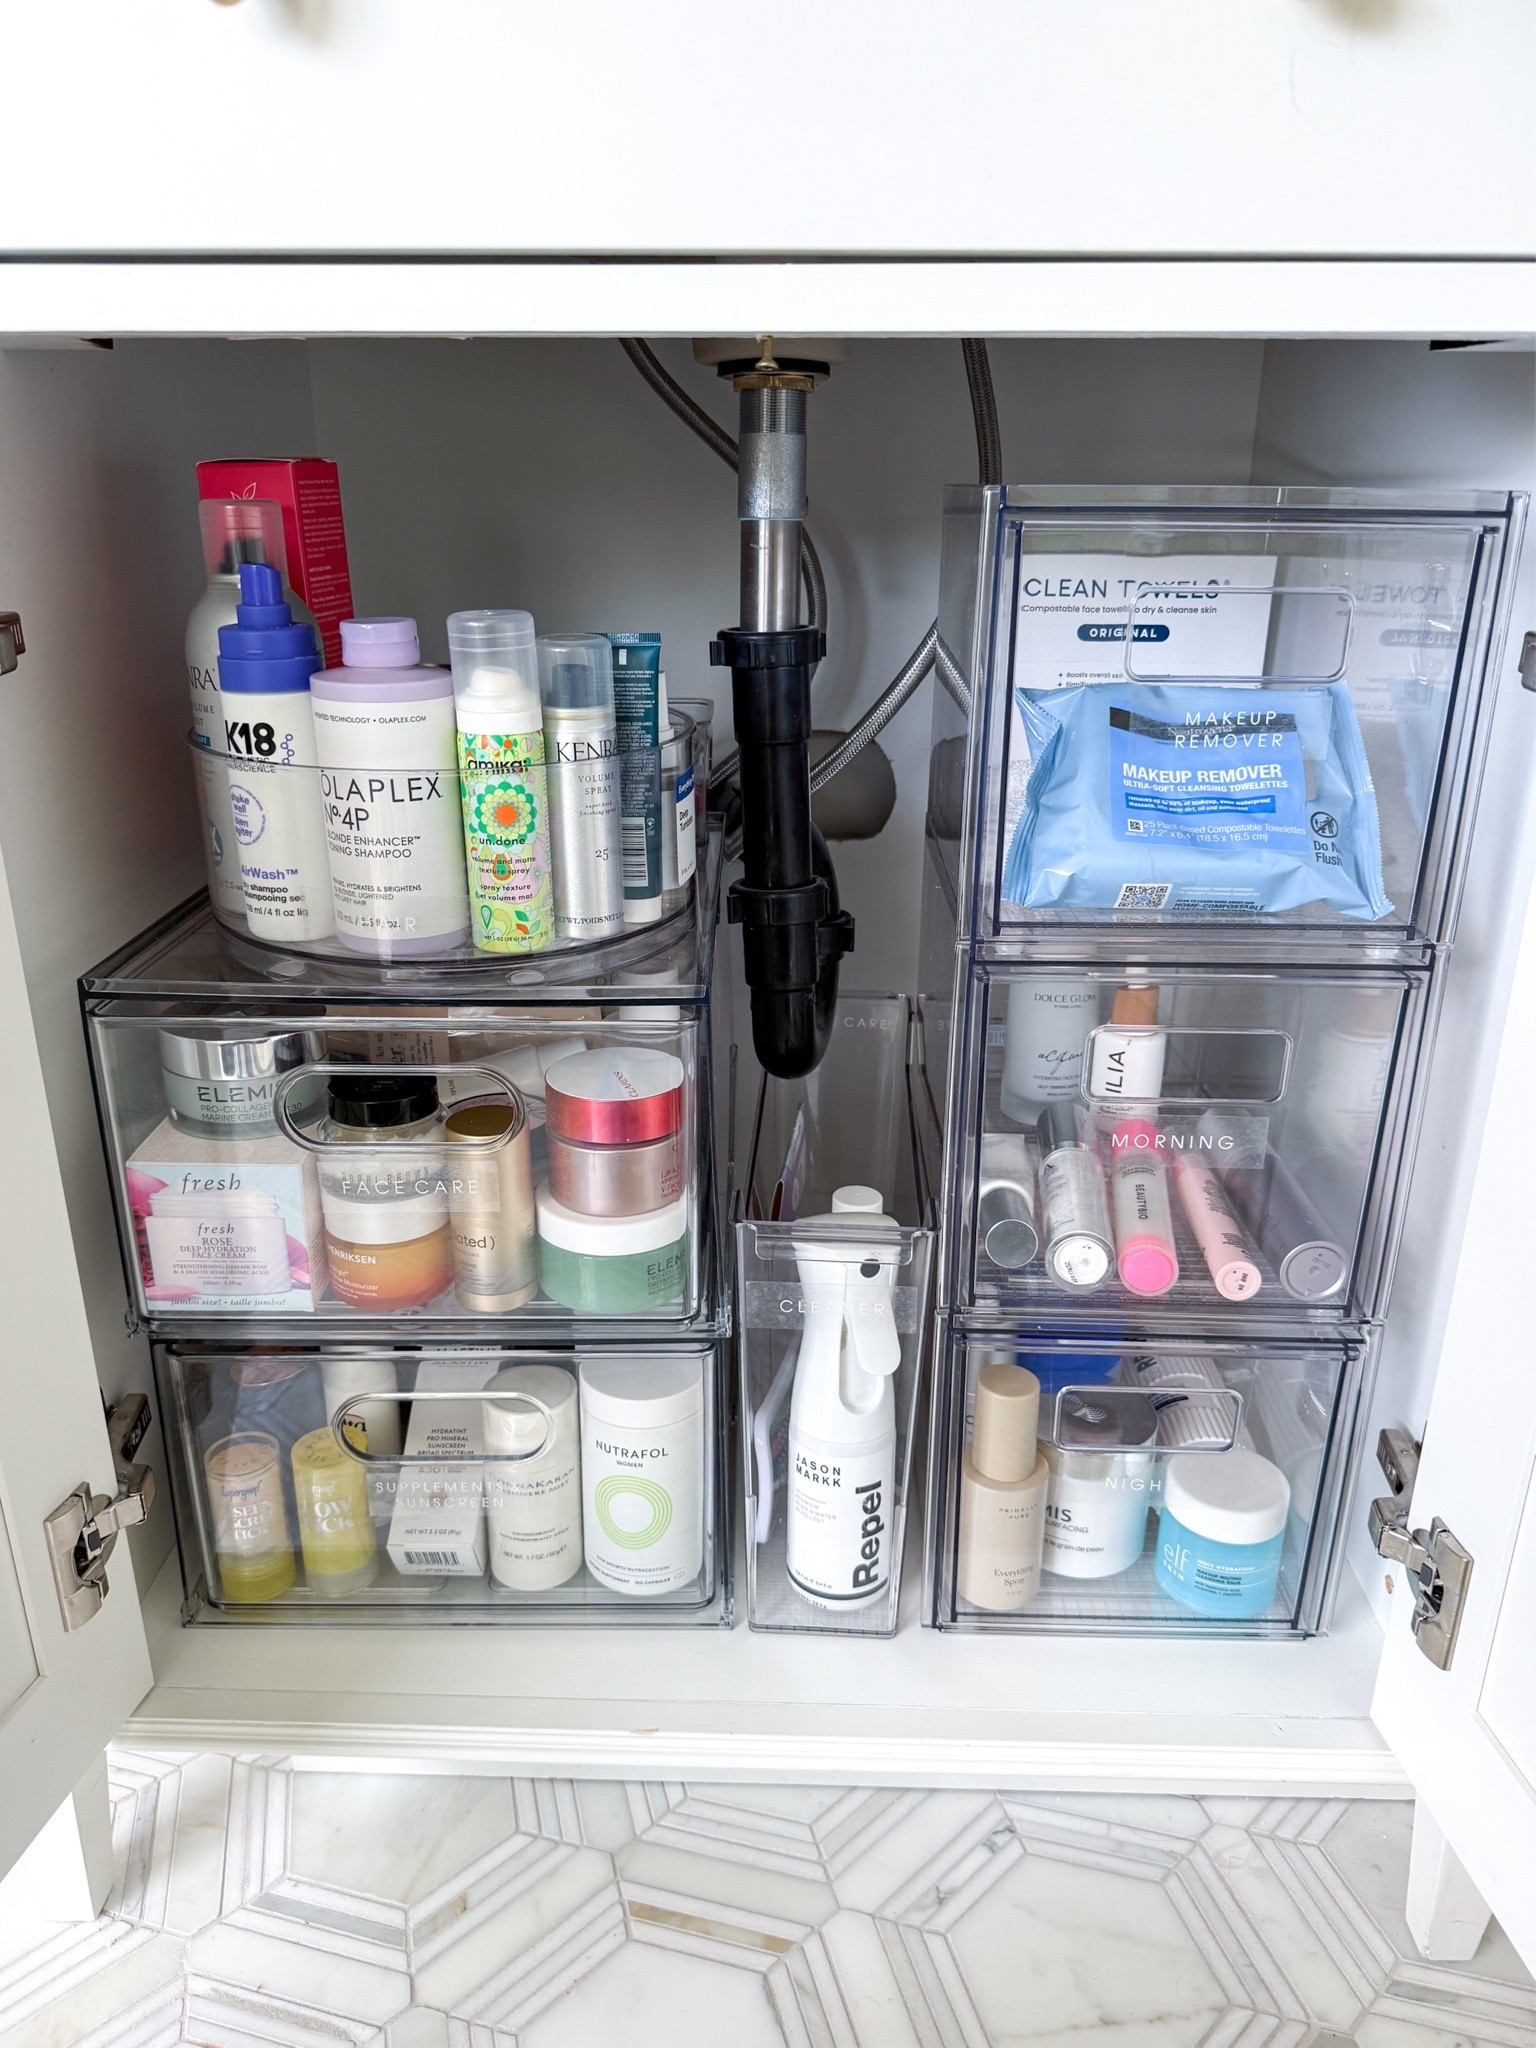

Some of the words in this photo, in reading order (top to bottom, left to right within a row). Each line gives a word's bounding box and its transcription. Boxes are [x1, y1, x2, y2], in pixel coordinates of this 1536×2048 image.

[1023, 578, 1107, 598] CLEAN
[1021, 604, 1080, 614] Compostable
[1082, 605, 1100, 613] face
[1142, 606, 1155, 615] dry
[1166, 606, 1198, 614] cleanse
[329, 714, 370, 724] TECHNOLOGY
[378, 715, 427, 724] OLAPLEX.COM
[1185, 711, 1277, 726] MAKEUP
[225, 719, 276, 757] K18
[1174, 733, 1283, 748] REMOVER
[578, 772, 614, 783] VOLUME
[1123, 762, 1192, 783] MAKEUP
[1197, 764, 1282, 783] REMOVER
[585, 785, 612, 795] SPRAY
[1123, 779, 1174, 792] ULTRA-SOFT
[1177, 783, 1227, 793] CLEANSING
[1230, 780, 1288, 791] TOWELETTES
[1236, 797, 1271, 806] waterproof
[1144, 820, 1155, 828] 25
[1208, 823, 1262, 834] Compostable
[1265, 823, 1306, 835] Towelettes
[479, 836, 526, 846] un.done
[1197, 834, 1219, 843] (18.5
[1230, 832, 1249, 842] 16.5
[1252, 832, 1268, 843] cm)
[1313, 840, 1328, 851] Do
[355, 847, 412, 859] SHAMPOO
[595, 847, 609, 861] 25
[1315, 852, 1344, 866] Flush
[473, 856, 494, 865] volume
[497, 856, 513, 865] and
[515, 856, 537, 864] matte
[479, 866, 505, 876] texture
[508, 867, 530, 878] spray
[250, 884, 288, 894] shampoo
[346, 882, 375, 892] HYDRATES
[383, 884, 422, 893] BRIGHTENS
[480, 884, 500, 893] spray
[358, 892, 394, 900] LIGHTENED
[488, 893, 516, 901] volume
[1034, 991, 1068, 1003] DOLCE
[1070, 994, 1096, 1003] GLOW
[844, 1017, 888, 1030] CARE
[1105, 1050, 1126, 1094] ILIA
[201, 1113, 236, 1122] MARINE
[238, 1111, 272, 1122] CREAM
[1111, 1133, 1235, 1150] MORNING
[182, 1172, 242, 1195] fresh
[342, 1181, 405, 1195] FACE
[415, 1180, 478, 1194] CARE
[1135, 1183, 1149, 1220] BEAUTYBIO
[198, 1223, 235, 1237] fresh
[202, 1237, 233, 1246] ROSE
[171, 1297, 199, 1306] jumbo
[202, 1298, 221, 1306] size!
[230, 1297, 251, 1306] taille
[254, 1298, 286, 1308] jumbo!
[595, 1438, 669, 1459] NUTRAFOL
[616, 1459, 644, 1468] WOMEN
[796, 1452, 842, 1477] JASON
[796, 1463, 842, 1488] MARKK
[376, 1481, 503, 1493] SUPPLEMENTS
[396, 1497, 504, 1509] SUNSCREEN
[852, 1479, 885, 1589] Repel
[1057, 1541, 1075, 1551] grain
[994, 1564, 1034, 1577] Everything
[1004, 1577, 1025, 1588] Spray
